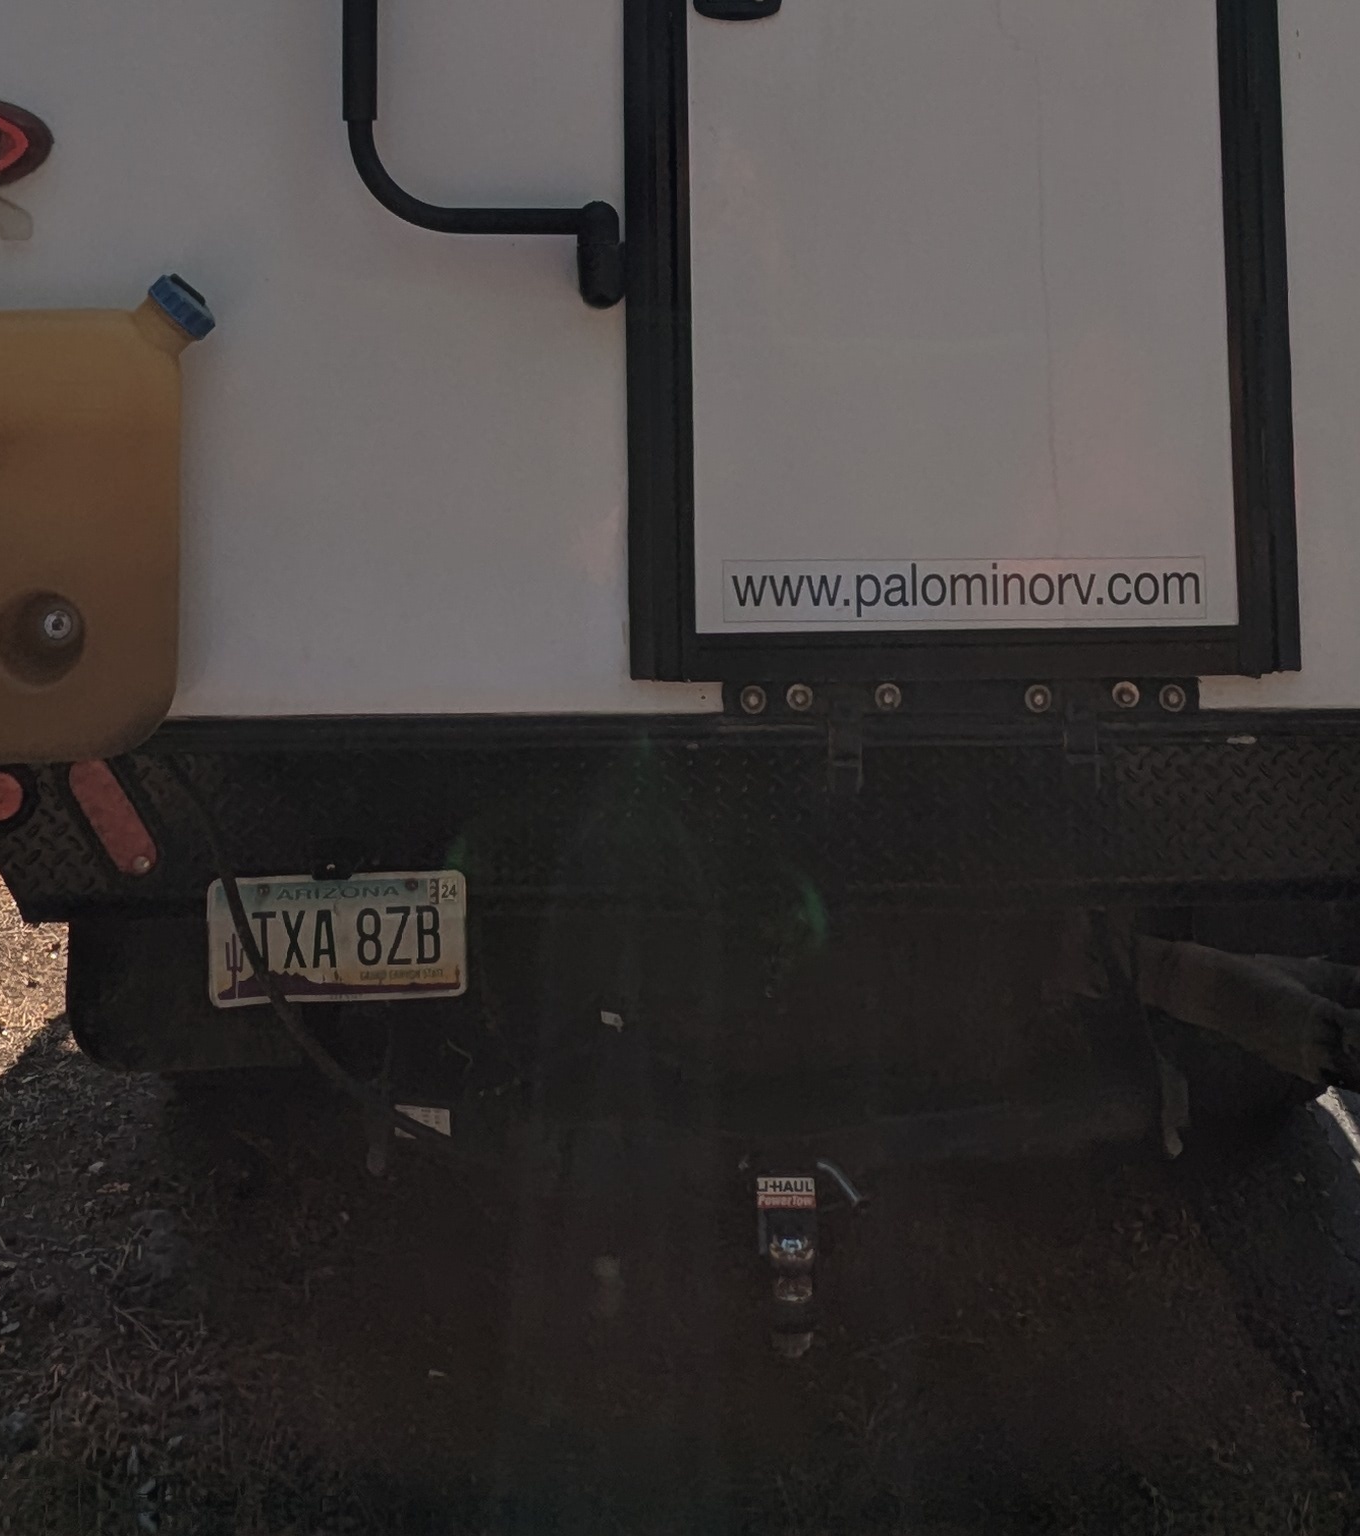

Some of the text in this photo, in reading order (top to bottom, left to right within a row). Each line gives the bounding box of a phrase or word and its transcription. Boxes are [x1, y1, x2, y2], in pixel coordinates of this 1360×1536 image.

[731, 562, 1202, 619] www.palominorv.com
[276, 885, 401, 901] ARIZONA
[440, 884, 458, 899] 24
[251, 905, 442, 969] TXA 8ZB
